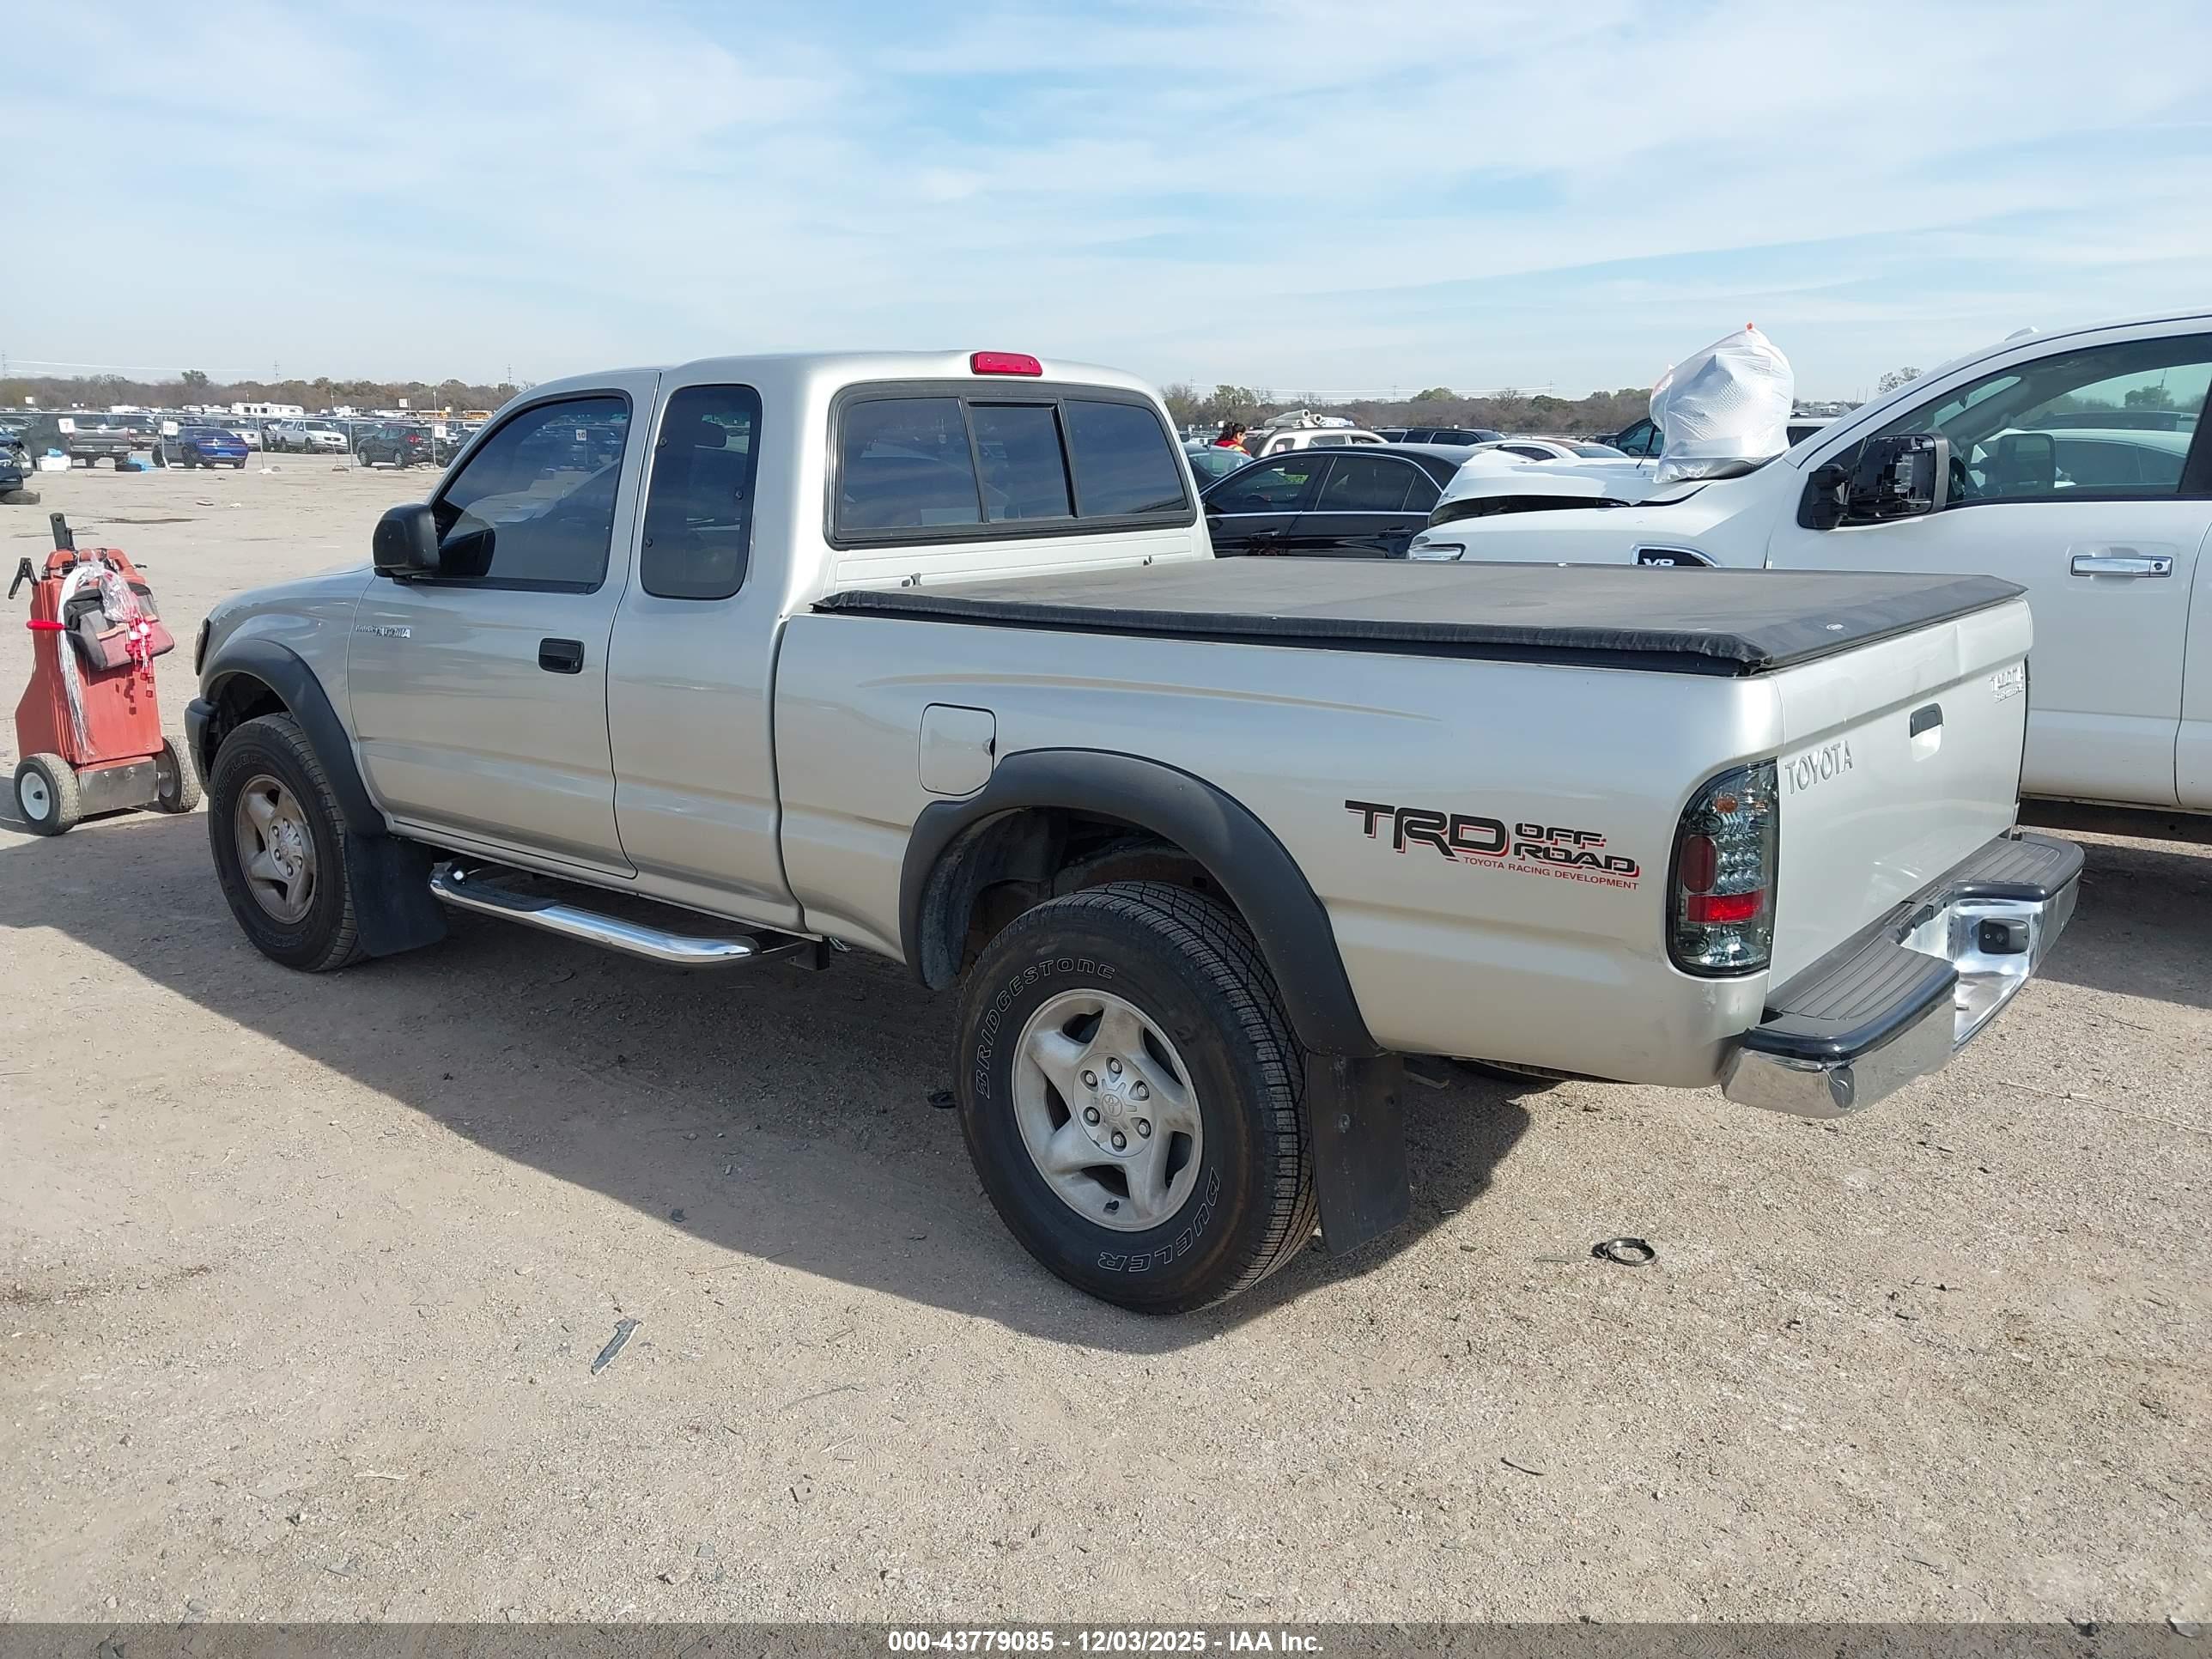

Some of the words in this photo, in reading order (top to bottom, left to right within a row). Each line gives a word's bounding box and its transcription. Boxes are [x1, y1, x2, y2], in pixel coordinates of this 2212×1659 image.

[1784, 740, 1853, 794] TOYOTA
[1345, 799, 1510, 862] TRD
[1515, 823, 1607, 848] OFF
[1462, 856, 1505, 870] TOYOTA
[1508, 863, 1551, 877] RACING
[1554, 870, 1639, 890] DEVELOPMENT
[1513, 842, 1640, 878] ROAD
[975, 957, 1116, 1099] BRIDGESTONE
[1097, 1166, 1222, 1273] DUELER
